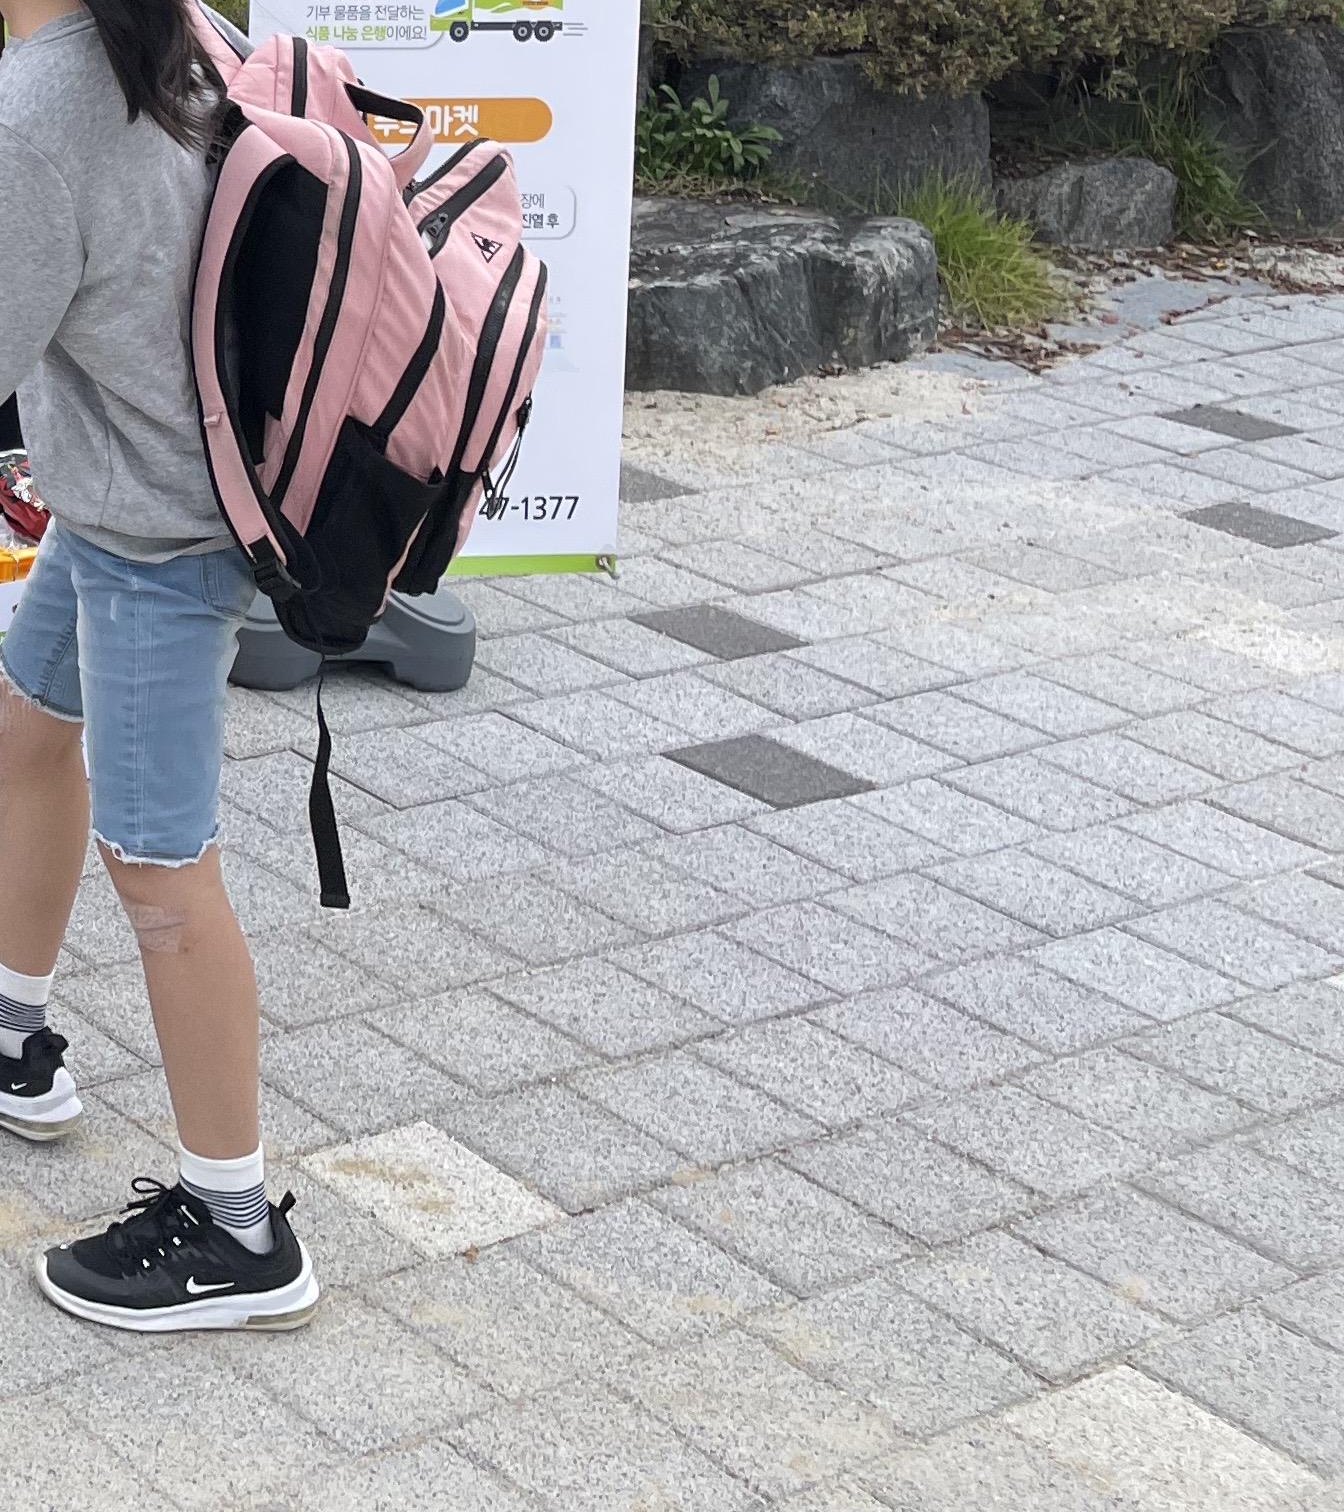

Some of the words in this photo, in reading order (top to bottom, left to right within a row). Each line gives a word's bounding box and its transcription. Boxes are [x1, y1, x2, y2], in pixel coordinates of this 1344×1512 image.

[306, 4, 331, 21] 기부
[334, 4, 371, 21] 물품을
[375, 4, 425, 21] 전달하는
[306, 25, 330, 41] 식품
[333, 25, 359, 41] 나눔
[361, 25, 428, 41] 은행이에요!
